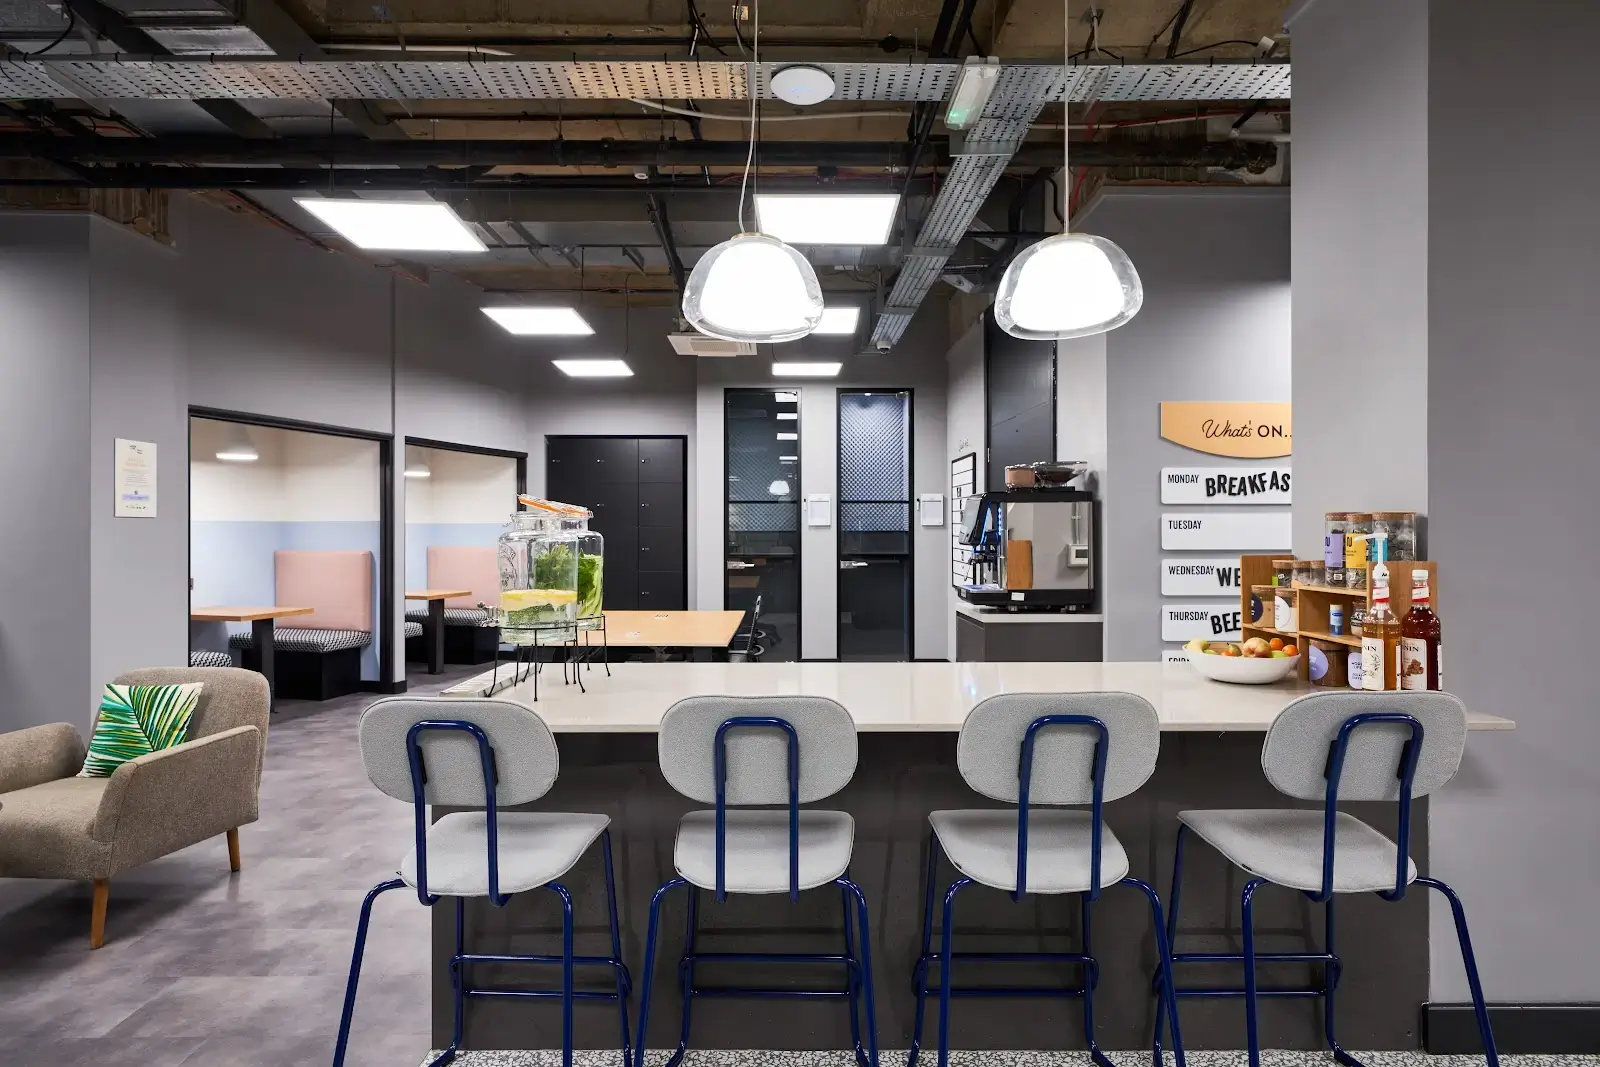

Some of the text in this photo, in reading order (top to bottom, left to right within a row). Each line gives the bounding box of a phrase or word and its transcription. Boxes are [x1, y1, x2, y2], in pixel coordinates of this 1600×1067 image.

[1201, 419, 1253, 438] What's
[1167, 470, 1291, 497] MONDAY BREAKFAS
[1168, 519, 1202, 530] TUESDAY
[1168, 565, 1215, 575] WEDNESDAY
[1168, 611, 1242, 635] THURSDAY BEE
